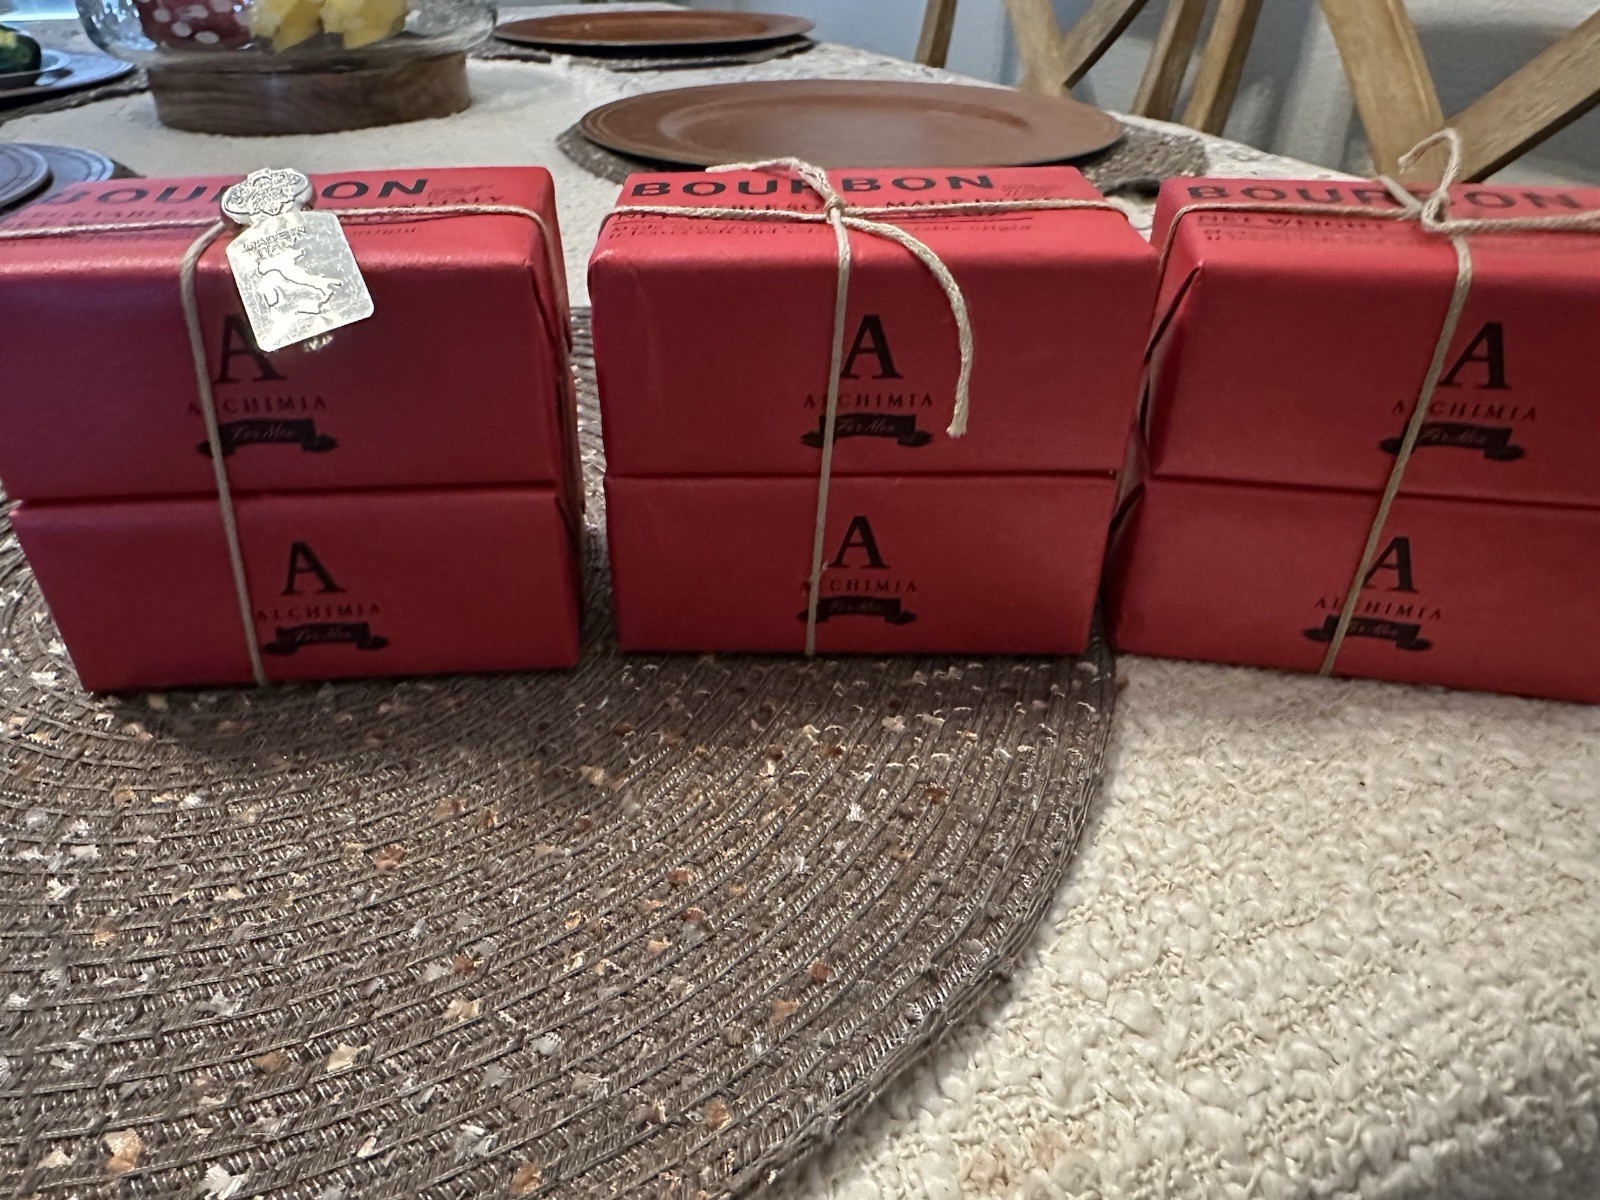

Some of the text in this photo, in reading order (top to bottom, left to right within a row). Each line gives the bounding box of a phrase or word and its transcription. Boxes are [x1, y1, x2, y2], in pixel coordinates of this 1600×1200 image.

[215, 313, 287, 384] A
[840, 313, 904, 380] A
[1436, 320, 1513, 390] A
[187, 395, 327, 416] ACHIMIA
[1391, 399, 1538, 421] ACHIMIA
[280, 540, 347, 596] A
[827, 514, 891, 569] A
[1359, 535, 1420, 593] A
[799, 577, 918, 593] ACHIMIA
[1313, 596, 1442, 621] ALHIMIA
